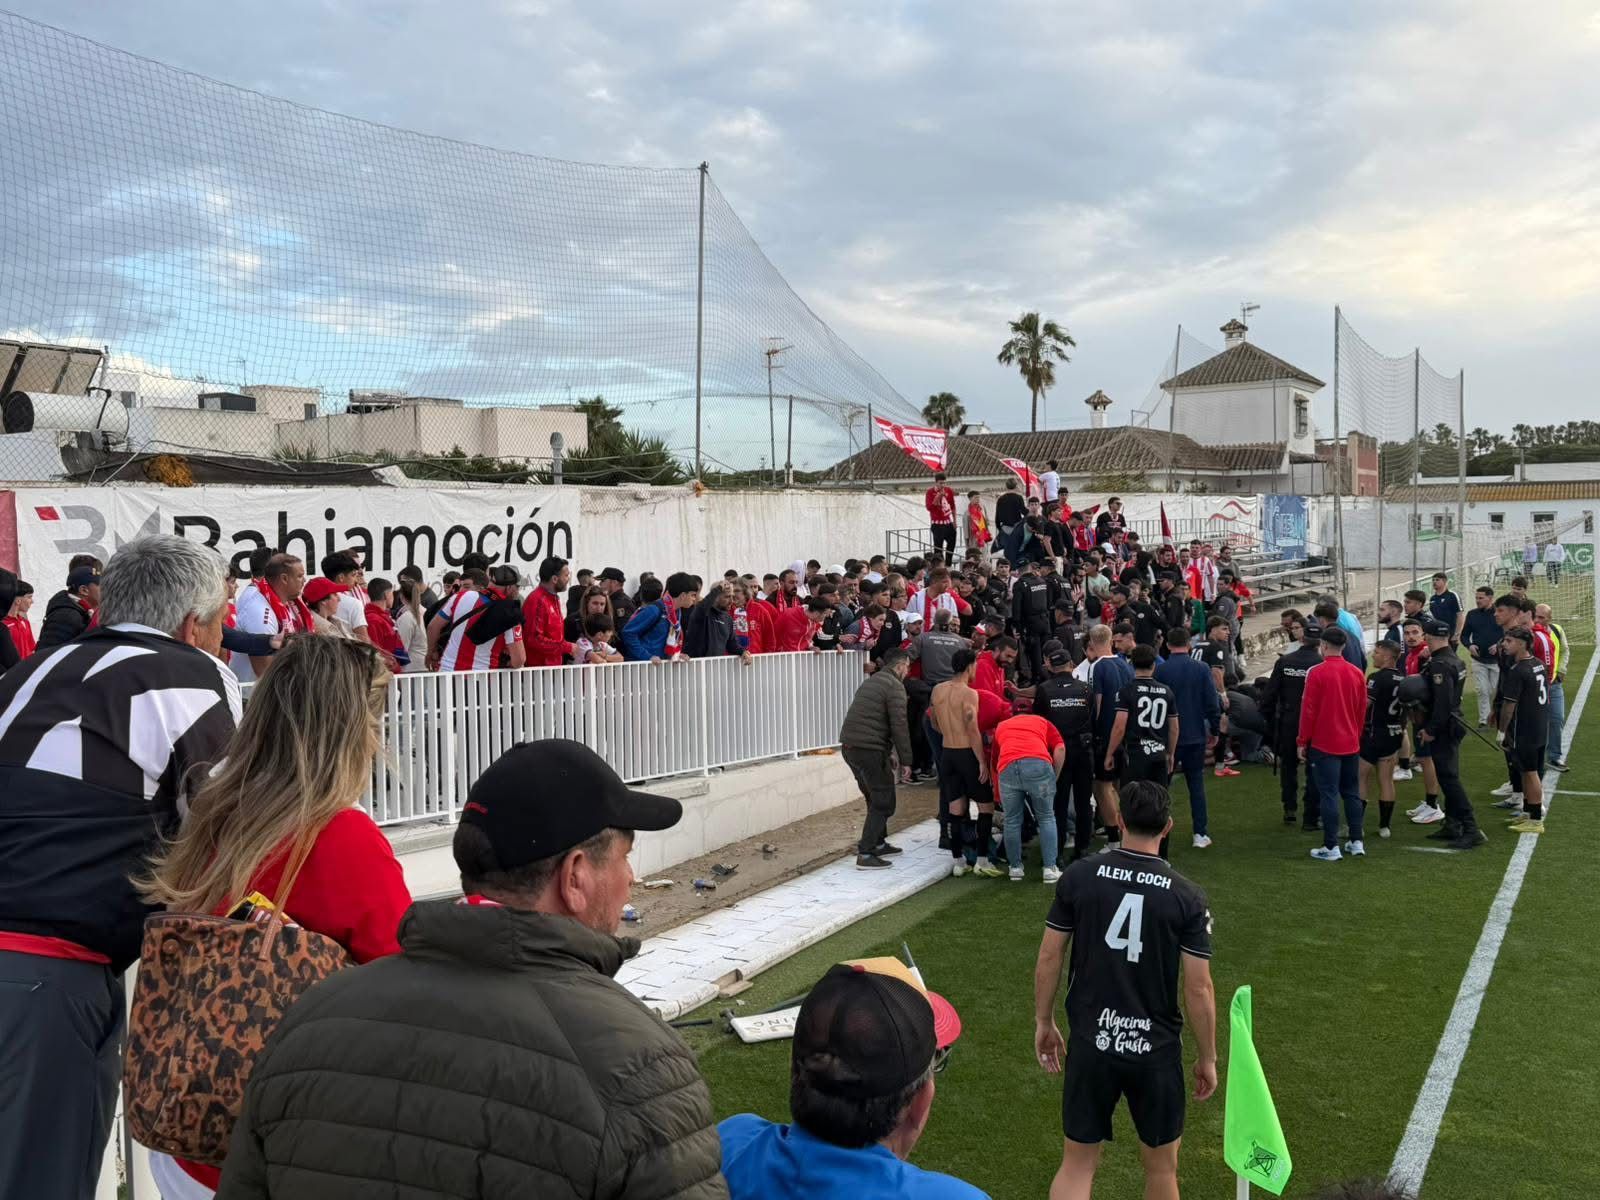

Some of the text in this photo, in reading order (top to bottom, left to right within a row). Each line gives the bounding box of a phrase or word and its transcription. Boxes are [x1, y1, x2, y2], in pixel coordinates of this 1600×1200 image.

[1536, 674, 1547, 705] 3
[1138, 696, 1168, 730] 20
[1096, 865, 1172, 889] ALEIX COCH
[1104, 892, 1145, 963] 4
[1097, 1007, 1153, 1036] Algeciras
[1114, 1031, 1153, 1055] Gusta
